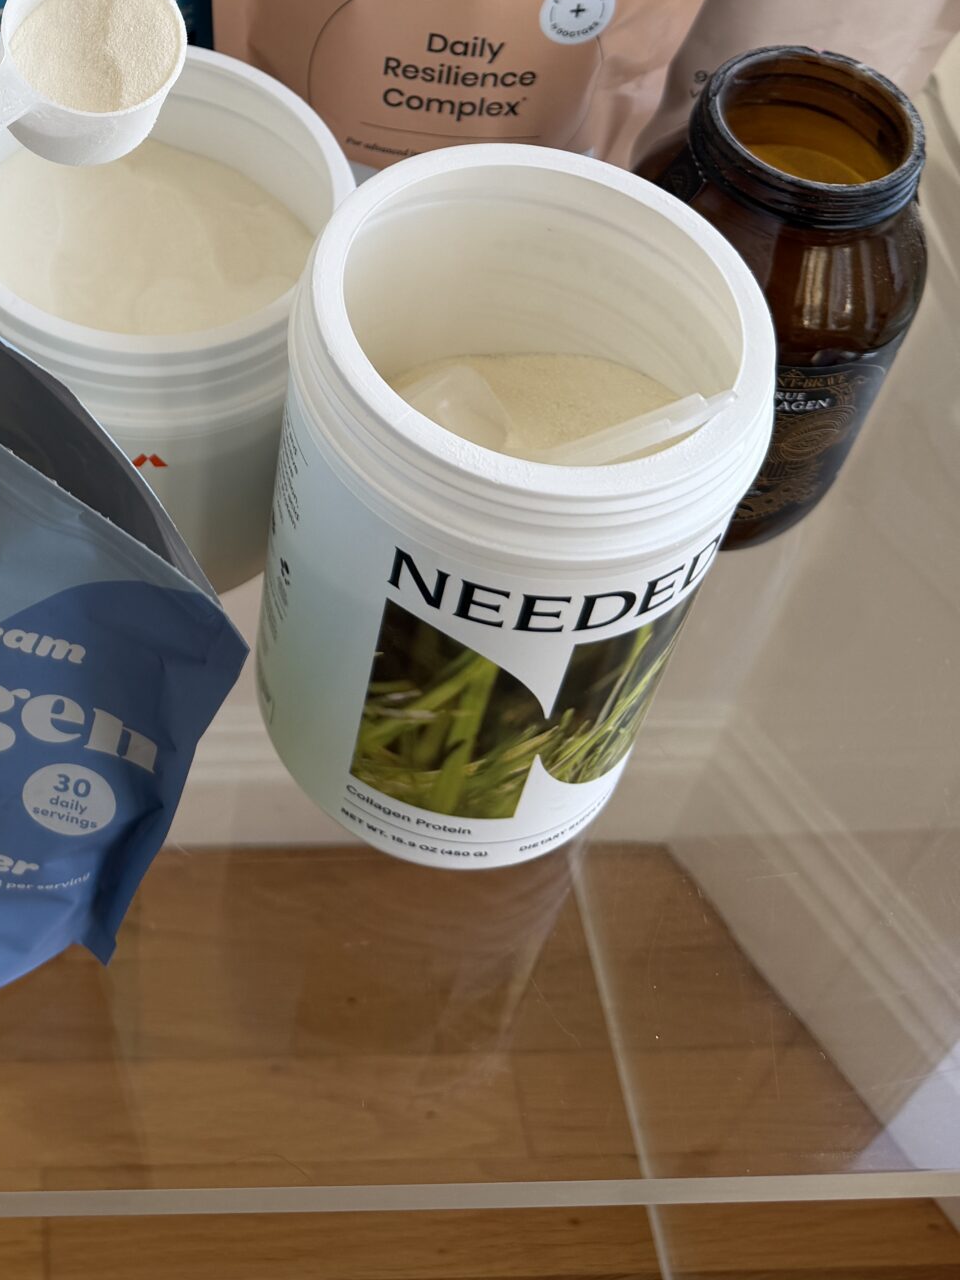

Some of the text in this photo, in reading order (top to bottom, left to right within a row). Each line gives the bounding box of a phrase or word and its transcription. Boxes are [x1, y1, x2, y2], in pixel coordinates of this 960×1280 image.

[426, 32, 506, 64] Daily
[382, 56, 538, 88] Resilience
[775, 391, 806, 401] RUE
[387, 532, 724, 633] NEEDED
[52, 773, 92, 798] 30
[32, 805, 98, 829] servings
[49, 795, 88, 815] daily
[345, 784, 472, 836] Collagen Protein
[340, 807, 365, 826] NET
[366, 823, 388, 839] WT.
[419, 844, 439, 855] OZ
[6, 881, 34, 890] per
